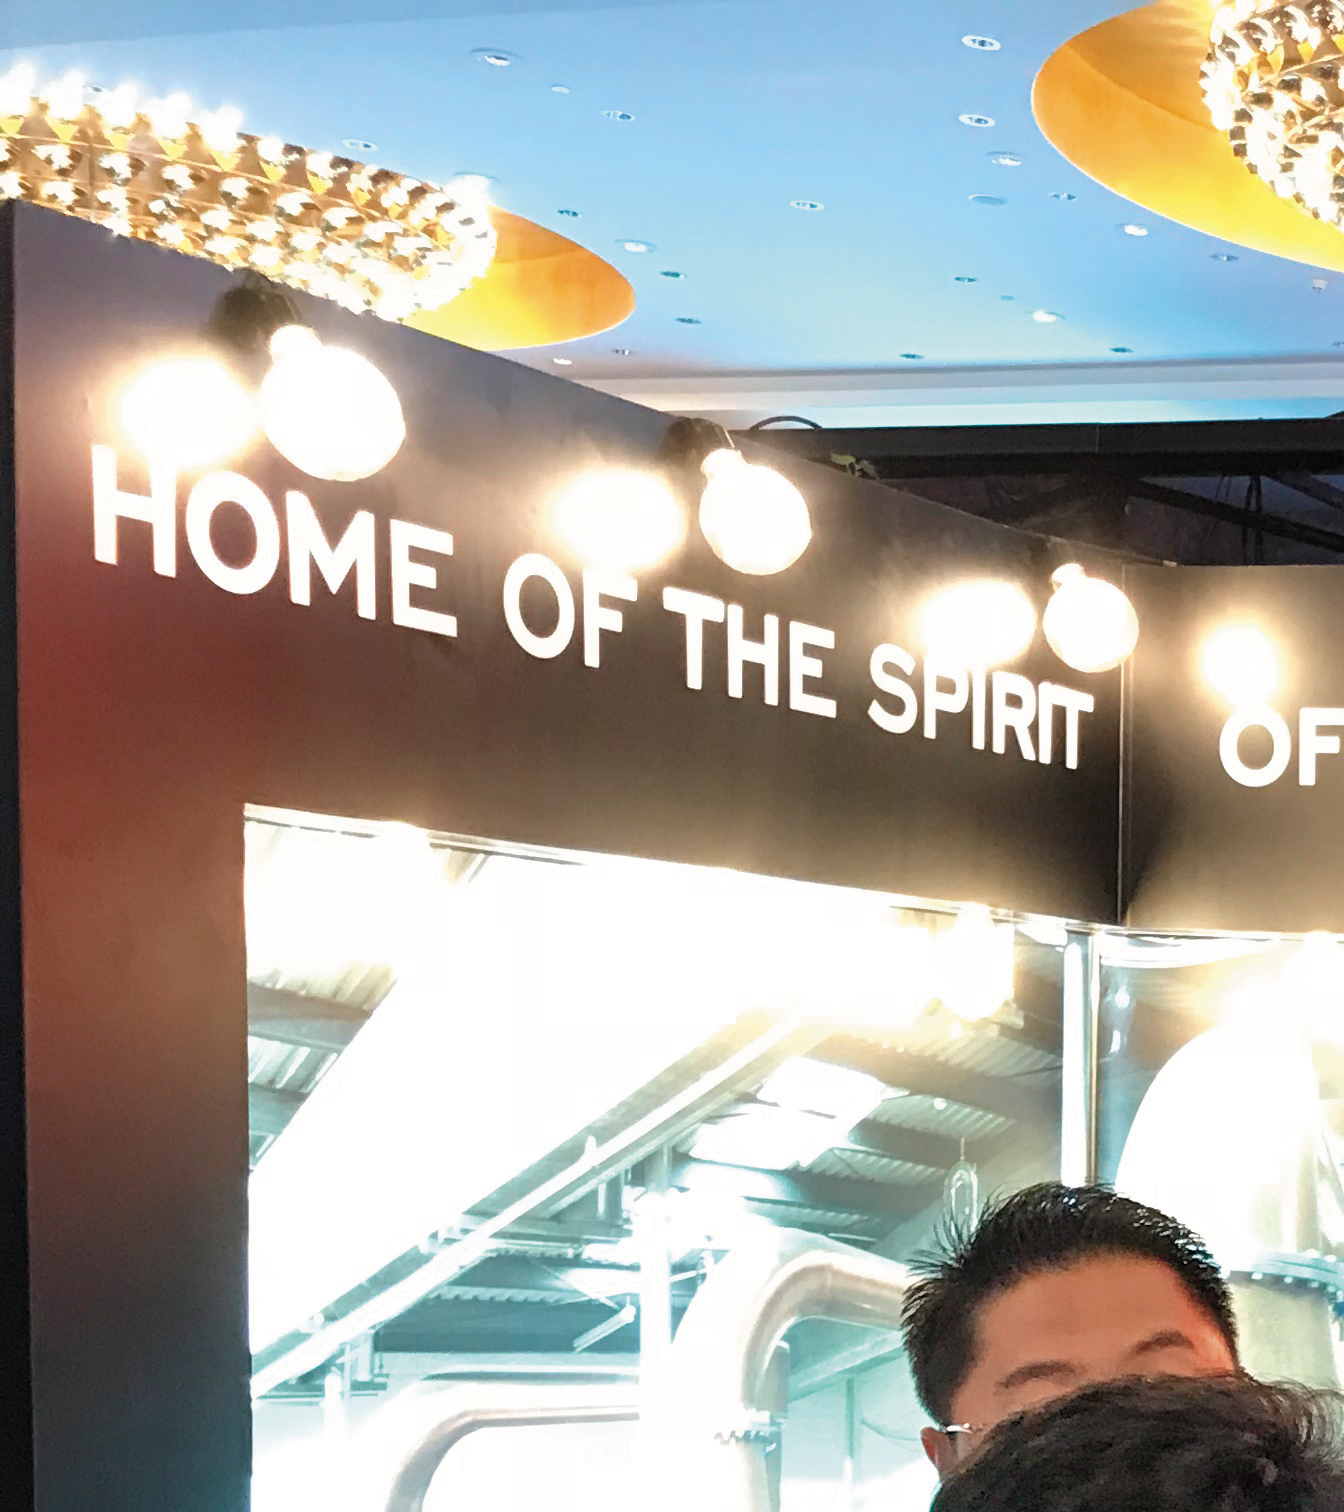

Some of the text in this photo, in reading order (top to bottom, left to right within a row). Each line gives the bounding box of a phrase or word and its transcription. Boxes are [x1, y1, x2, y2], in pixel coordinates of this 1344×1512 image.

[92, 443, 1094, 770] HOME OF THE SPIRIT
